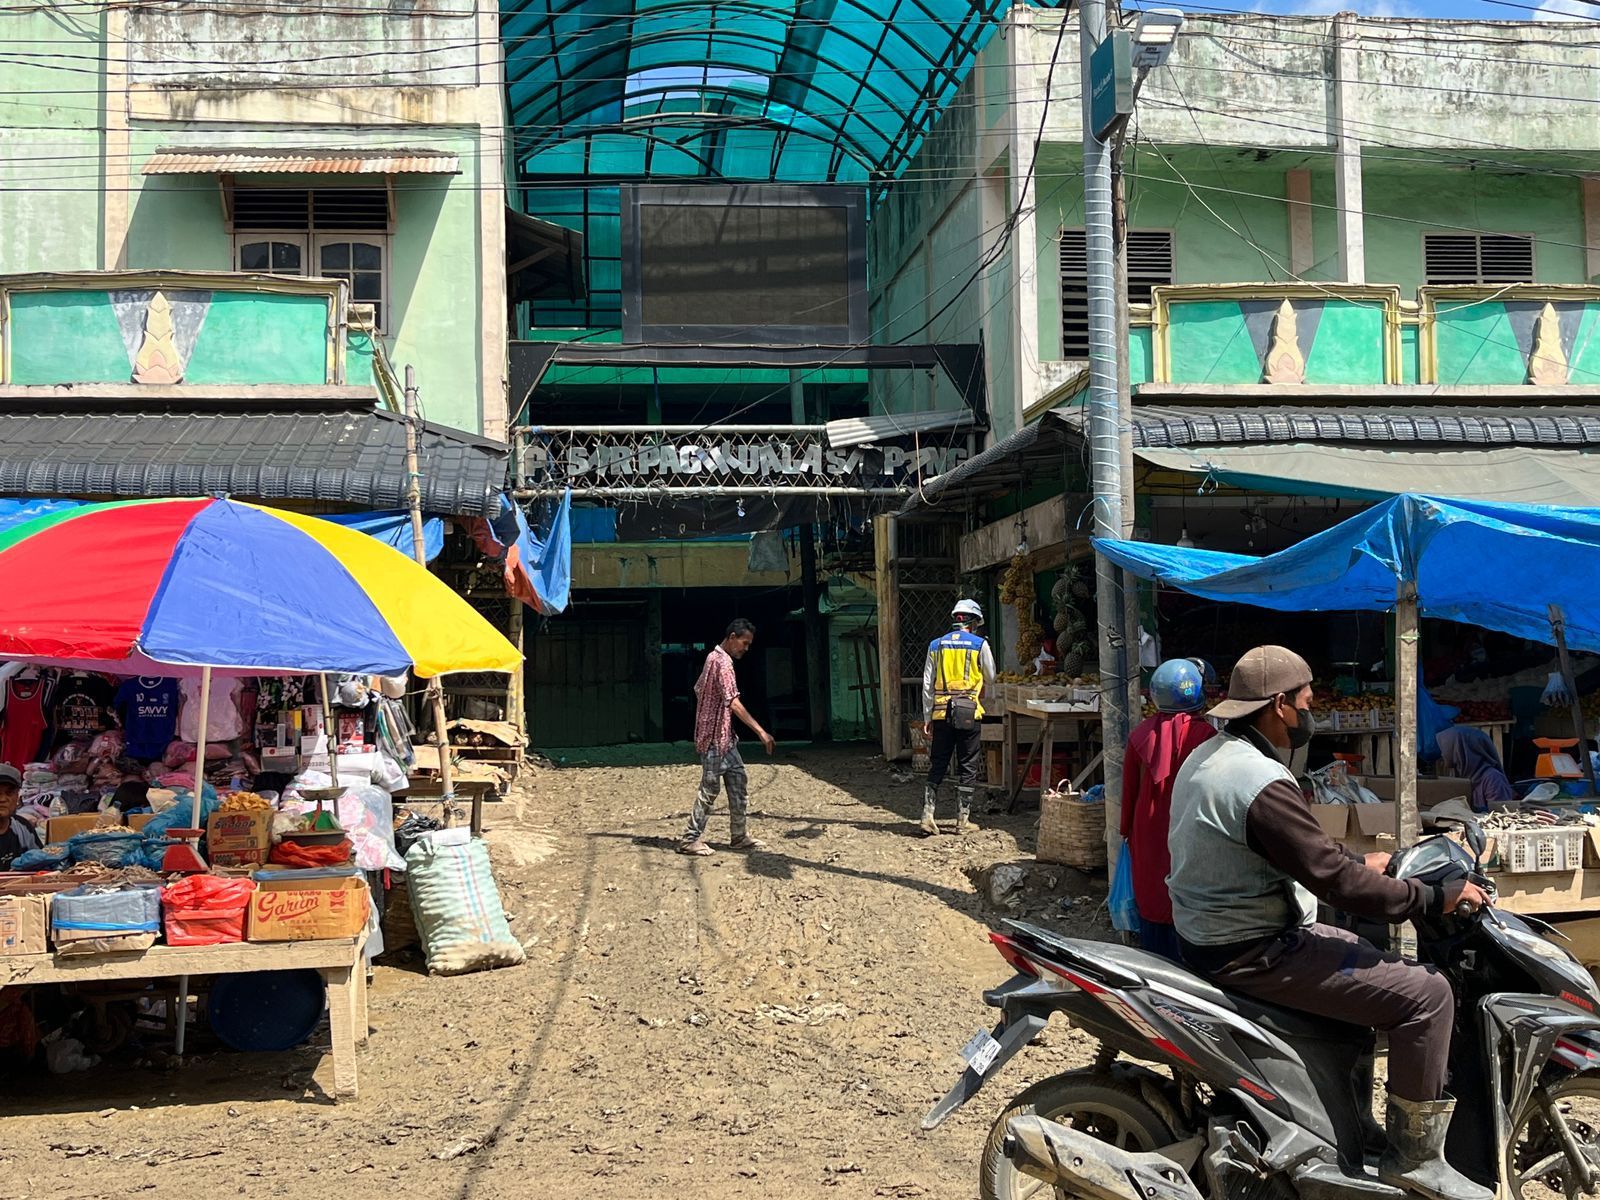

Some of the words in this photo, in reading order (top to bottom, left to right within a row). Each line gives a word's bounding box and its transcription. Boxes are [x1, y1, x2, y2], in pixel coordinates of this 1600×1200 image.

[525, 443, 633, 477] PSAR
[826, 445, 964, 476] SIPANG
[138, 706, 168, 714] SAVVY
